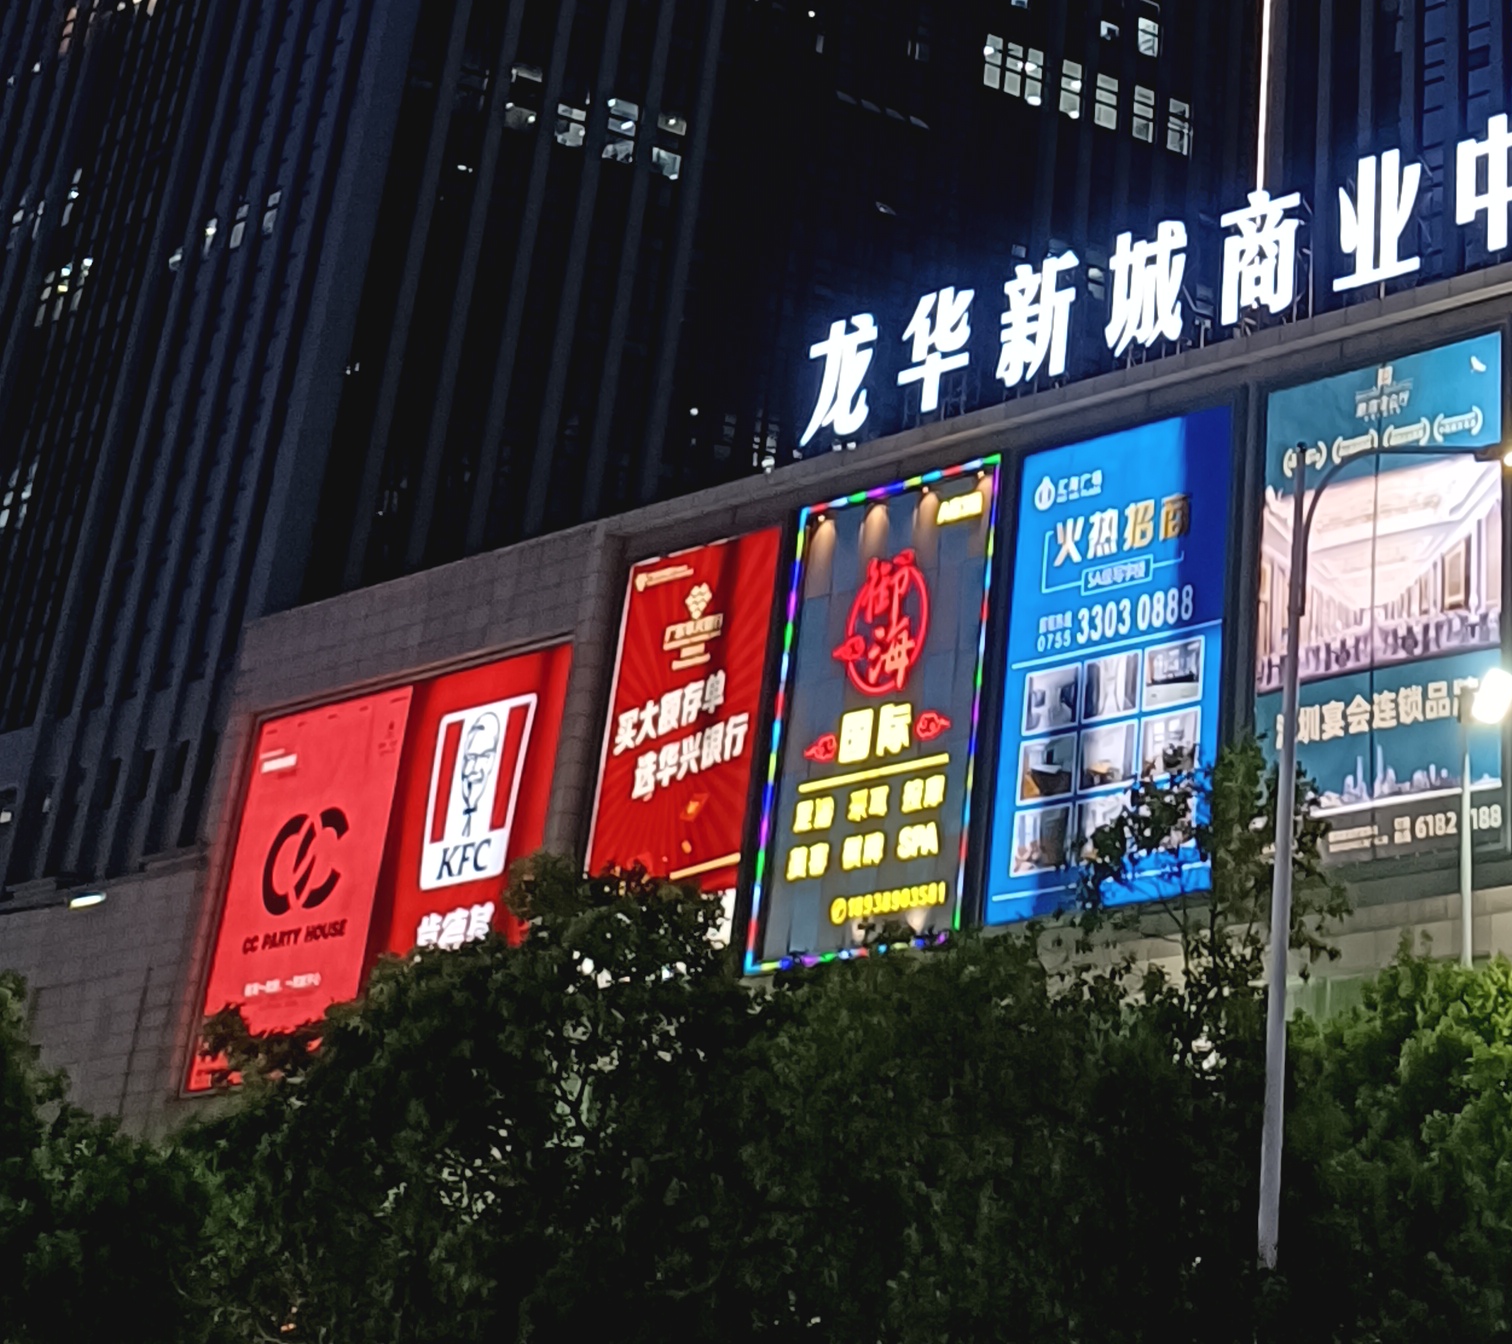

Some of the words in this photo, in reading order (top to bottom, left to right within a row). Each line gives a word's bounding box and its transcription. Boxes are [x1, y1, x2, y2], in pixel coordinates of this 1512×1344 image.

[1053, 492, 1191, 567] 火热招商
[1037, 630, 1071, 652] 0755
[1076, 598, 1131, 644] 3303
[1137, 584, 1194, 631] 0888
[613, 669, 726, 756] 买大额存单
[897, 821, 939, 860] SPA
[1415, 811, 1458, 839] 6182
[436, 838, 491, 881] KFC
[242, 935, 260, 955] CC
[261, 927, 302, 951] PARTY
[304, 919, 348, 943] HOUSE
